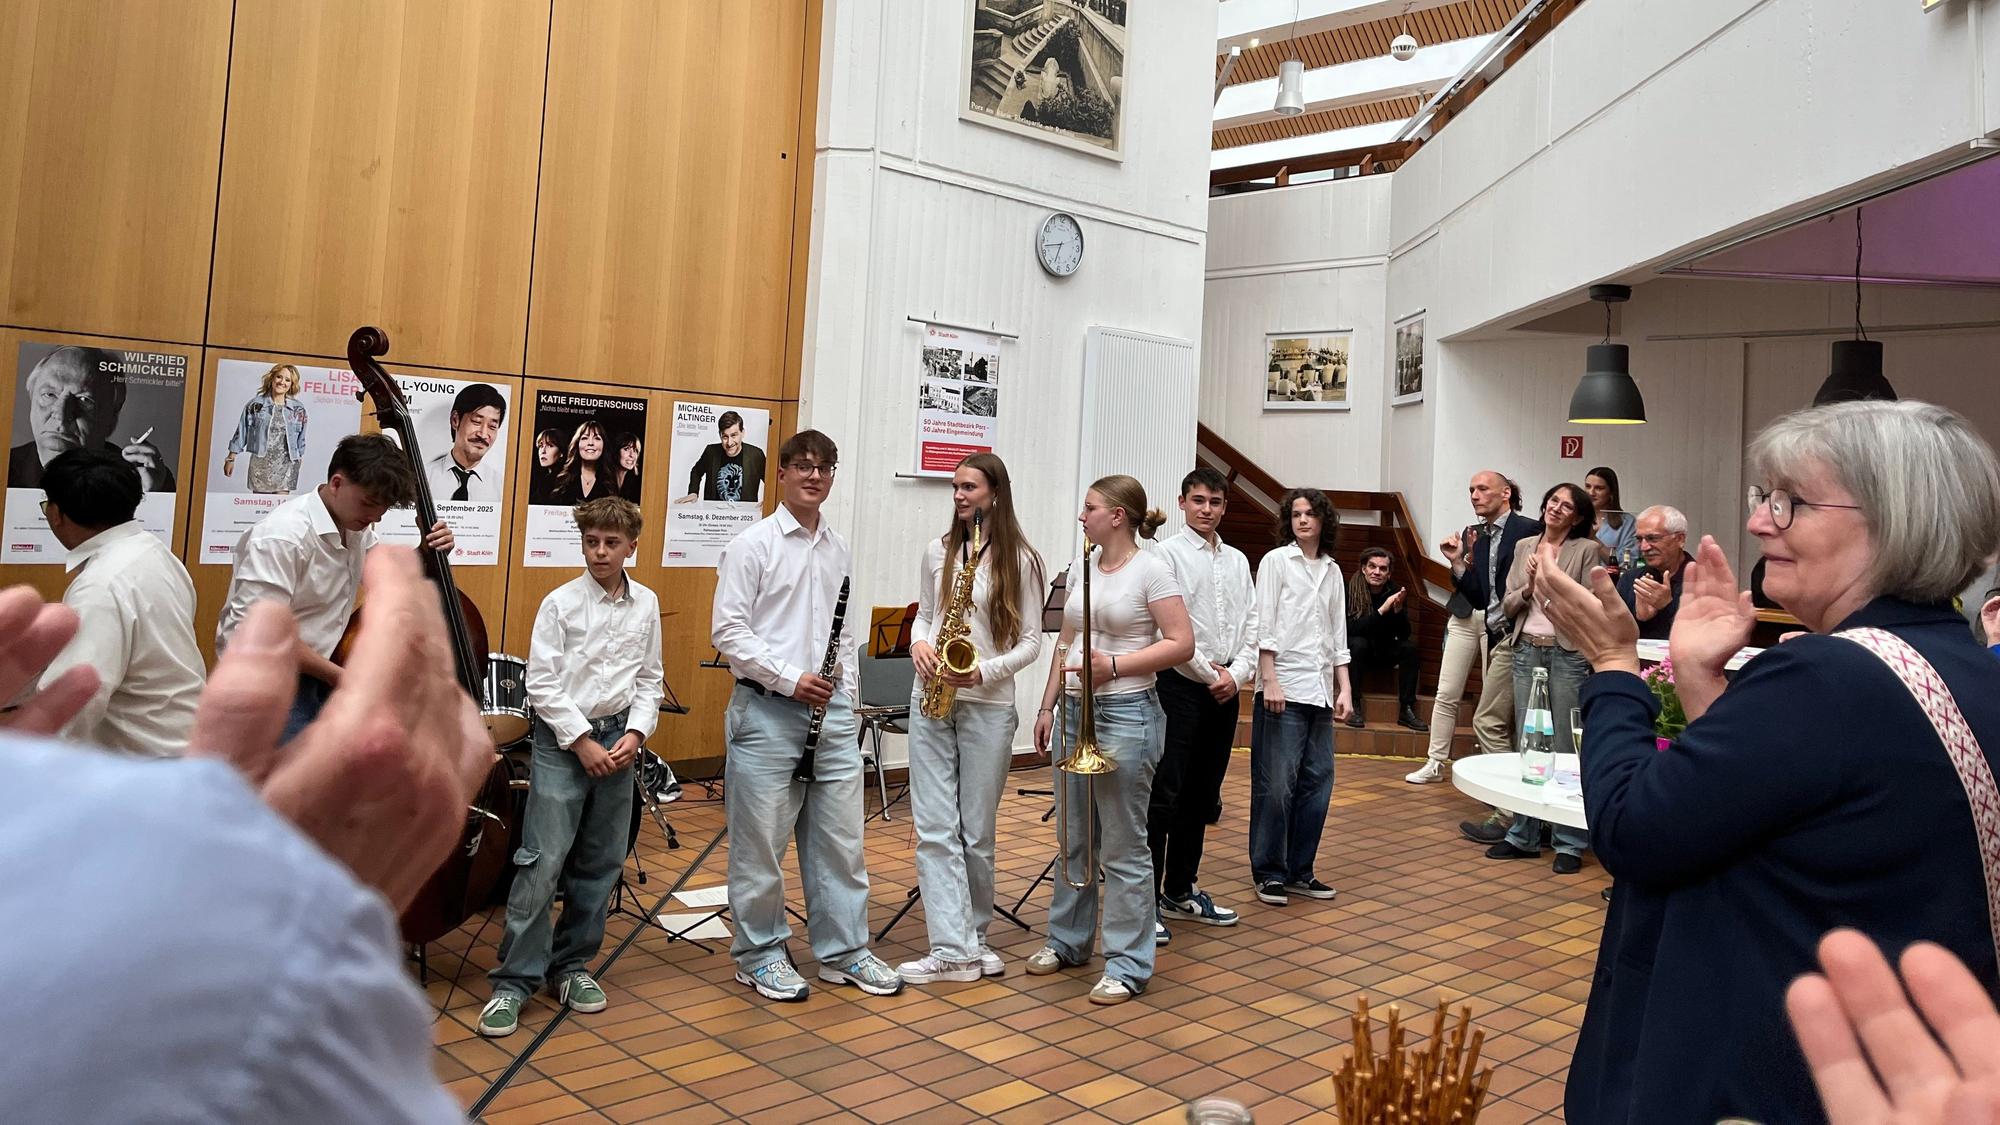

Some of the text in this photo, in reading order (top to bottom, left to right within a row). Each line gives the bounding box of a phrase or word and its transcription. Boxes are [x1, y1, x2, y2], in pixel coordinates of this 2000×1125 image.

[124, 352, 185, 366] WILFRIED
[98, 361, 185, 377] SCHMICKLER
[329, 370, 360, 383] LISA
[304, 381, 359, 396] FELLER
[399, 380, 455, 395] L-YOUNG
[540, 394, 644, 411] KATIE FREUDENSCHUSS
[677, 404, 713, 414] MICHAEL
[677, 413, 716, 423] ALTINGER
[932, 419, 946, 427] Jahre
[947, 420, 974, 429] Stadtbezirk
[931, 426, 946, 434] Jahre
[946, 428, 984, 439] Eingemeindung
[233, 497, 275, 507] Samstag,
[436, 503, 494, 513] September 2025
[711, 513, 740, 521] Dezember
